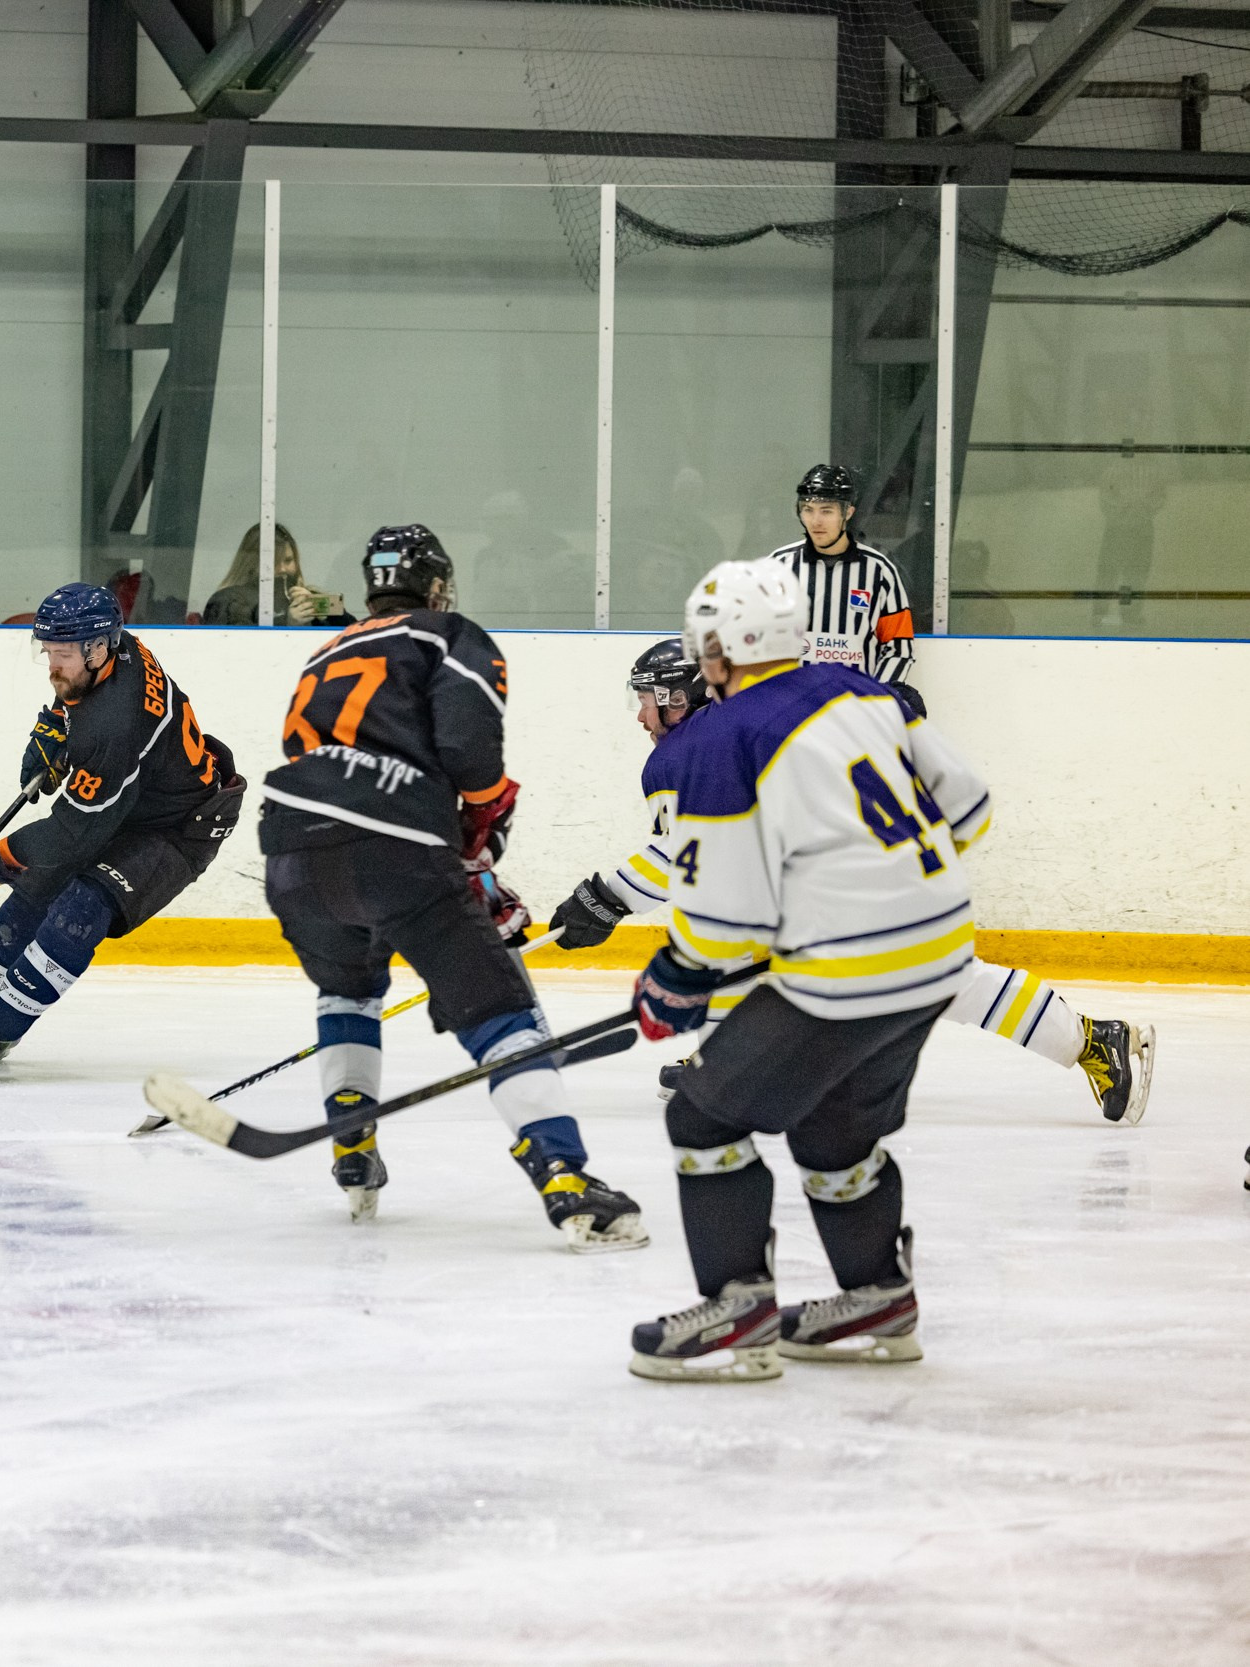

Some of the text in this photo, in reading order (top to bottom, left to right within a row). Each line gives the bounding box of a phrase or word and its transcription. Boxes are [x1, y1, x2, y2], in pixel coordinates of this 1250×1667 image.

[373, 567, 397, 587] 37
[35, 623, 51, 631] CCM
[93, 621, 112, 629] CCM
[816, 637, 849, 649] БАНК
[815, 650, 863, 661] РОССИЯ
[209, 826, 235, 838] CC
[96, 862, 134, 893] CCM
[13, 968, 37, 990] CCM
